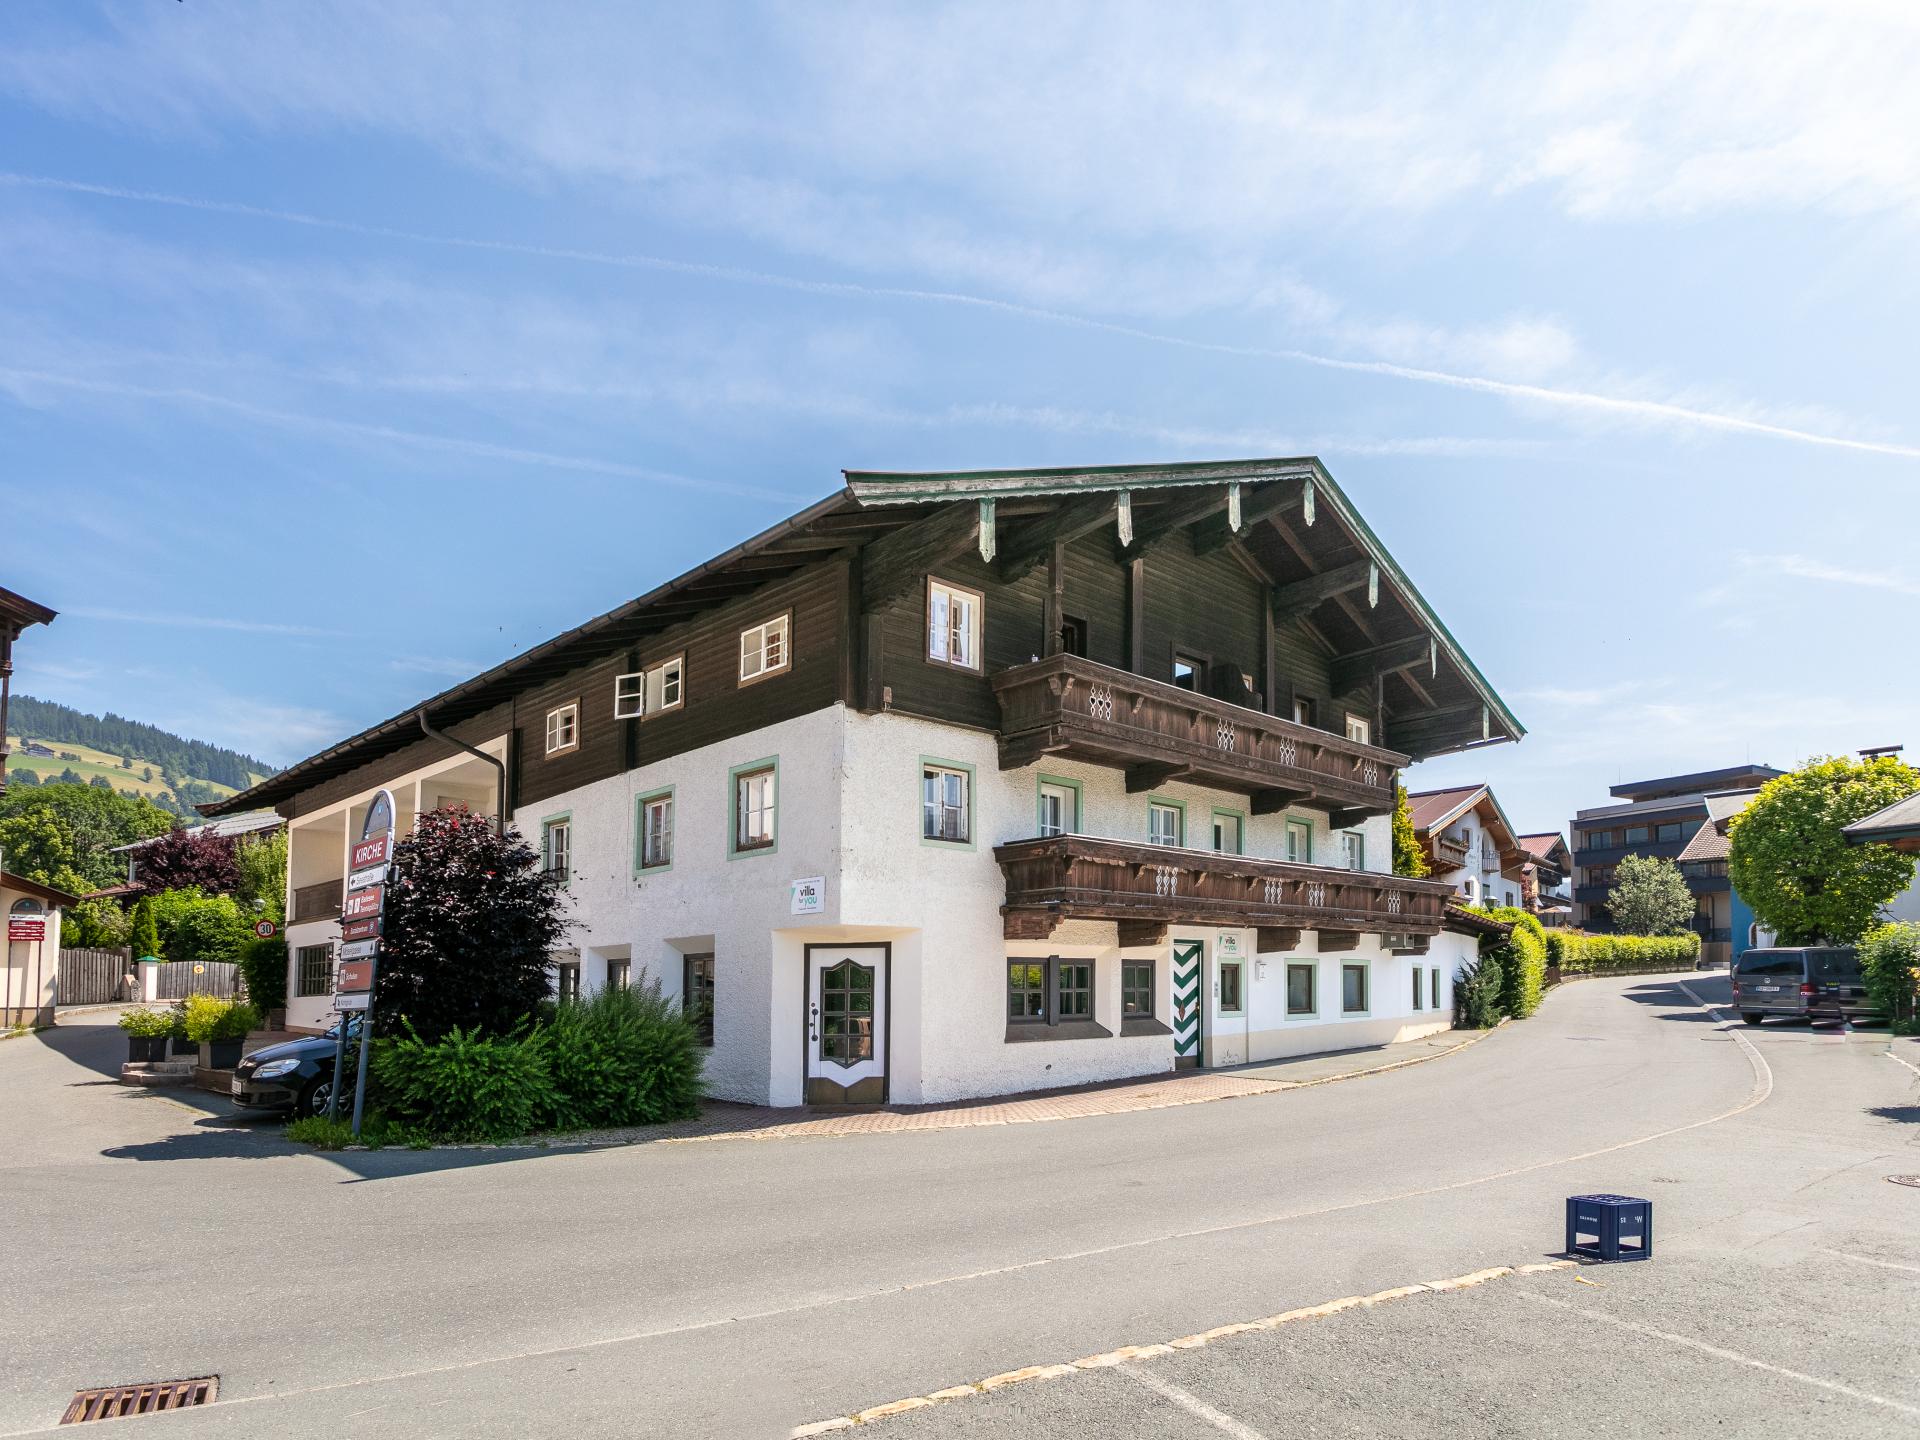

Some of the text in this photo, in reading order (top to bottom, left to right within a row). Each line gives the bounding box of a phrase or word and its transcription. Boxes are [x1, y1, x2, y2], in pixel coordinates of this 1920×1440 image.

[355, 841, 383, 864] KIRCHE
[800, 885, 815, 896] villa
[260, 924, 271, 934] 30
